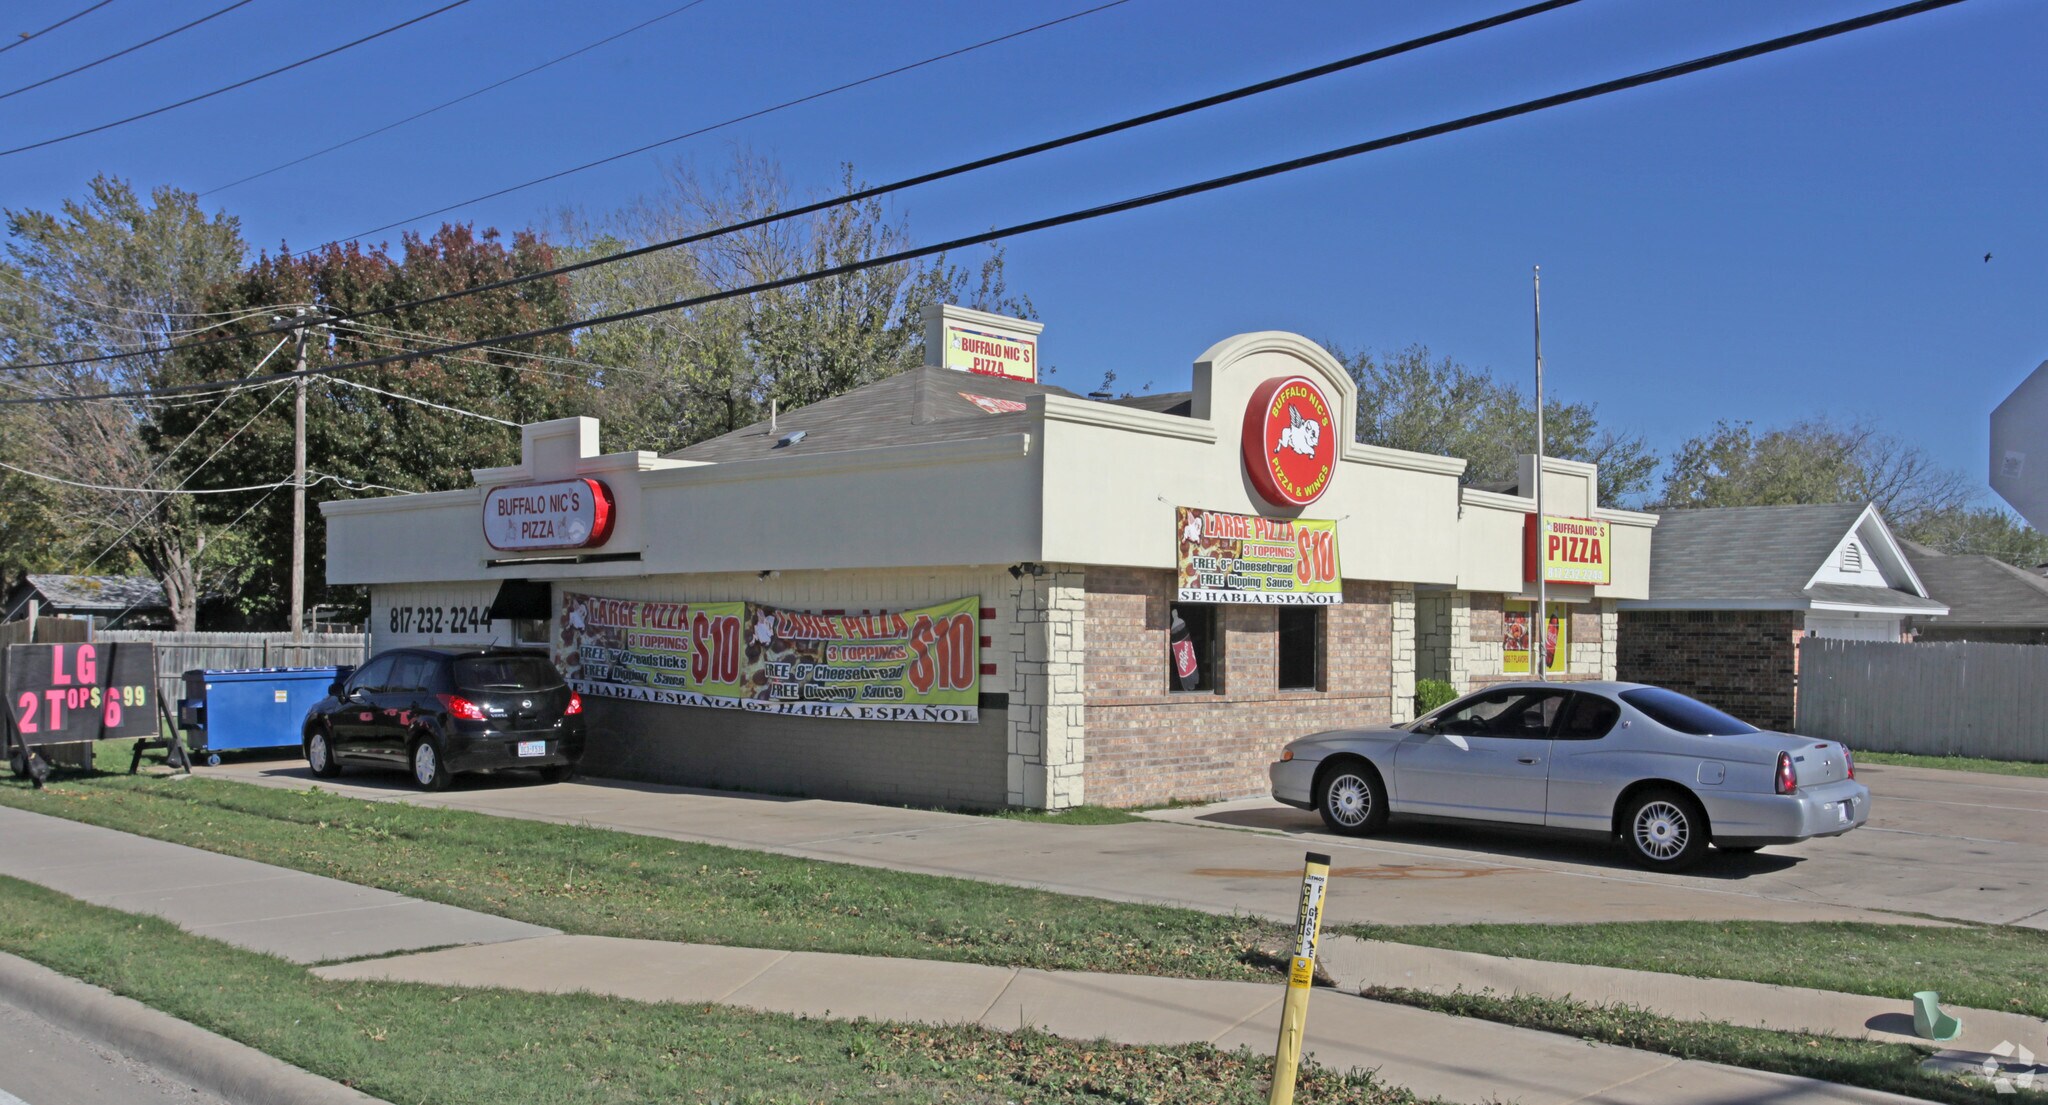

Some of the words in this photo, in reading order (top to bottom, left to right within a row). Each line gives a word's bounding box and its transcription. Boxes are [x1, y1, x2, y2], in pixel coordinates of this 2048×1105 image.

[962, 337, 1002, 358] BUFFALO
[974, 357, 1004, 374] PIZZA
[1272, 386, 1307, 418] BUFFALO
[1309, 393, 1329, 426] NIC'S
[1272, 457, 1293, 494] PIZZA
[1296, 486, 1302, 497] &
[1304, 465, 1329, 496] WINGS
[498, 496, 546, 516] BUFFALO
[550, 490, 580, 512] NIC'S
[522, 520, 555, 539] PIZZA
[1204, 512, 1250, 540] LARGE
[1254, 517, 1295, 542] PIZZA
[1553, 522, 1584, 536] BUFFALO
[1244, 545, 1250, 556] 3
[1253, 546, 1296, 558] TOPPINGS
[1297, 527, 1336, 584] $10
[1548, 534, 1602, 564] PIZZA
[1193, 558, 1217, 570] FREE
[1234, 560, 1293, 574] Cheesebread
[1201, 574, 1225, 586] FREE
[1228, 576, 1262, 589] Dipping
[1266, 577, 1293, 588] Sauce
[1180, 591, 1202, 601] SE
[1206, 592, 1262, 604] HABLA
[1266, 592, 1341, 604] ESPAÑOL
[390, 606, 492, 634] 817-232-2244
[588, 598, 639, 628] LARGE
[641, 602, 690, 632] PIZZA
[776, 610, 842, 640] LARGE
[842, 612, 908, 640] PIZZA
[628, 634, 636, 647] 3
[639, 634, 688, 651] TOPPINGS
[691, 611, 740, 686] $10
[827, 646, 836, 660] 3
[841, 644, 908, 661] TOPPINGS
[908, 613, 974, 694] $10
[53, 644, 96, 685] LG
[580, 646, 605, 660] FREE
[620, 650, 687, 669] Breadsticks
[584, 664, 608, 678] FREE
[765, 662, 790, 678] FREE
[814, 664, 904, 682] Cheesebread
[588, 684, 648, 700] HABLA
[771, 683, 798, 698] FREE
[805, 684, 856, 700] Dipping
[862, 685, 904, 698] Sauce
[18, 692, 38, 734] 2
[778, 704, 854, 719] HABLA
[859, 705, 978, 722] ESPAÑOL
[1296, 886, 1310, 954] CAUTION
[1306, 908, 1315, 936] GAS
